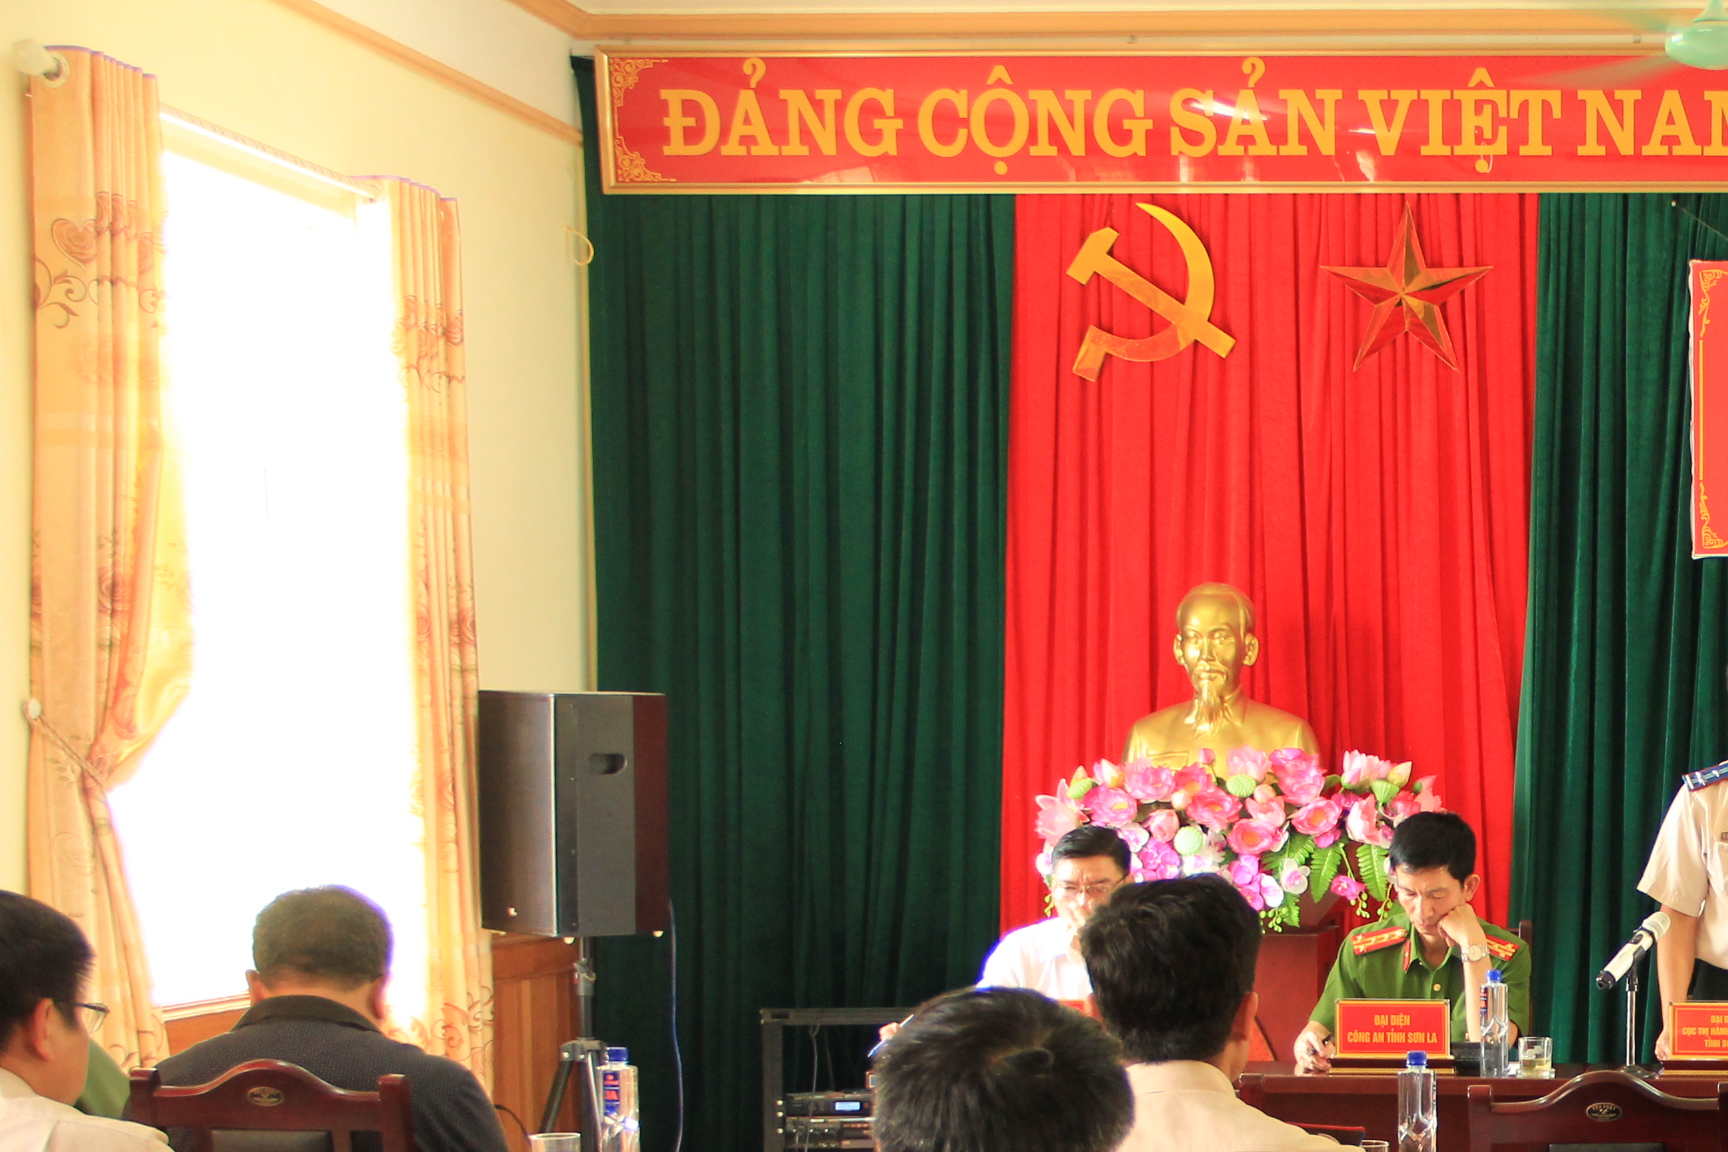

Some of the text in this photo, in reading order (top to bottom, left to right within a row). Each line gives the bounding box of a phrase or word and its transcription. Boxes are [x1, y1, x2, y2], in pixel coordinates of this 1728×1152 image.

[661, 57, 904, 157] ĐẢNG
[917, 65, 1154, 176] CỘNG
[1169, 57, 1344, 157] SẢN
[1357, 67, 1562, 174] VIỆT
[1374, 1012, 1411, 1029] ĐẠI DIỆN
[1710, 1014, 1723, 1025] ĐẠI
[1347, 1027, 1438, 1043] CÔNG AN TỈNH SƠN LA
[1682, 1026, 1697, 1037] CỤC
